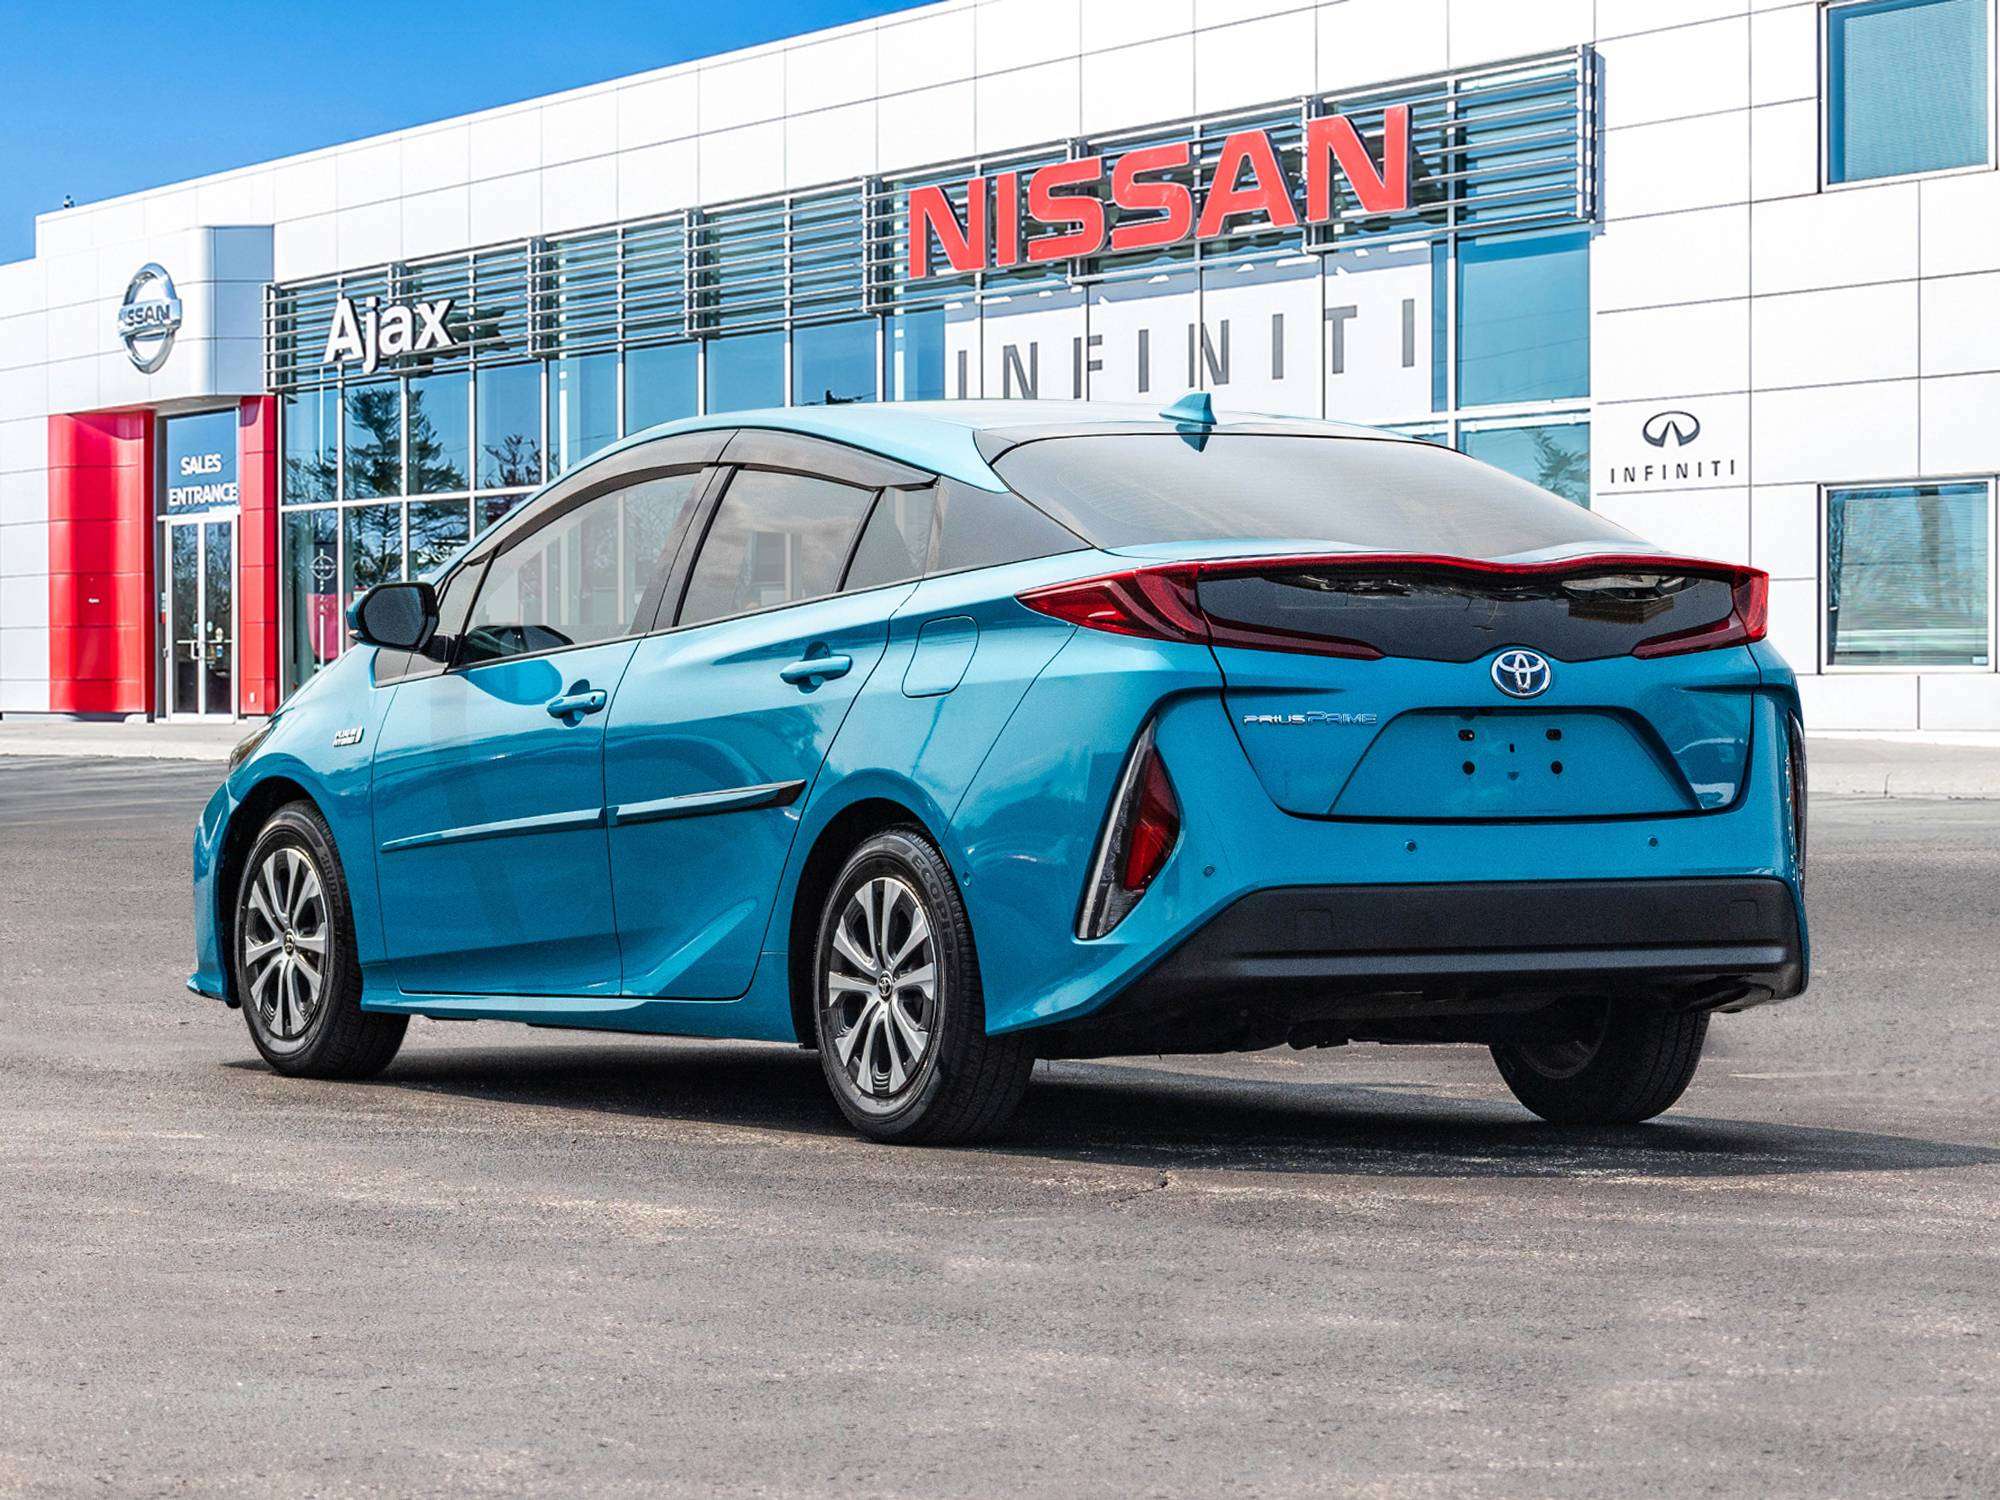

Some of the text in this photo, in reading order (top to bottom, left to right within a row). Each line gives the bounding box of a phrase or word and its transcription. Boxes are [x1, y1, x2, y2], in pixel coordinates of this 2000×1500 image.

[908, 104, 1411, 280] NISSAN
[323, 296, 453, 373] Ajax
[957, 298, 1415, 399] INFINITI
[180, 453, 222, 476] SALES
[1610, 458, 1735, 484] INFINITI
[169, 483, 238, 506] ENTRANCE
[1243, 711, 1377, 726] PRIUS PRIME
